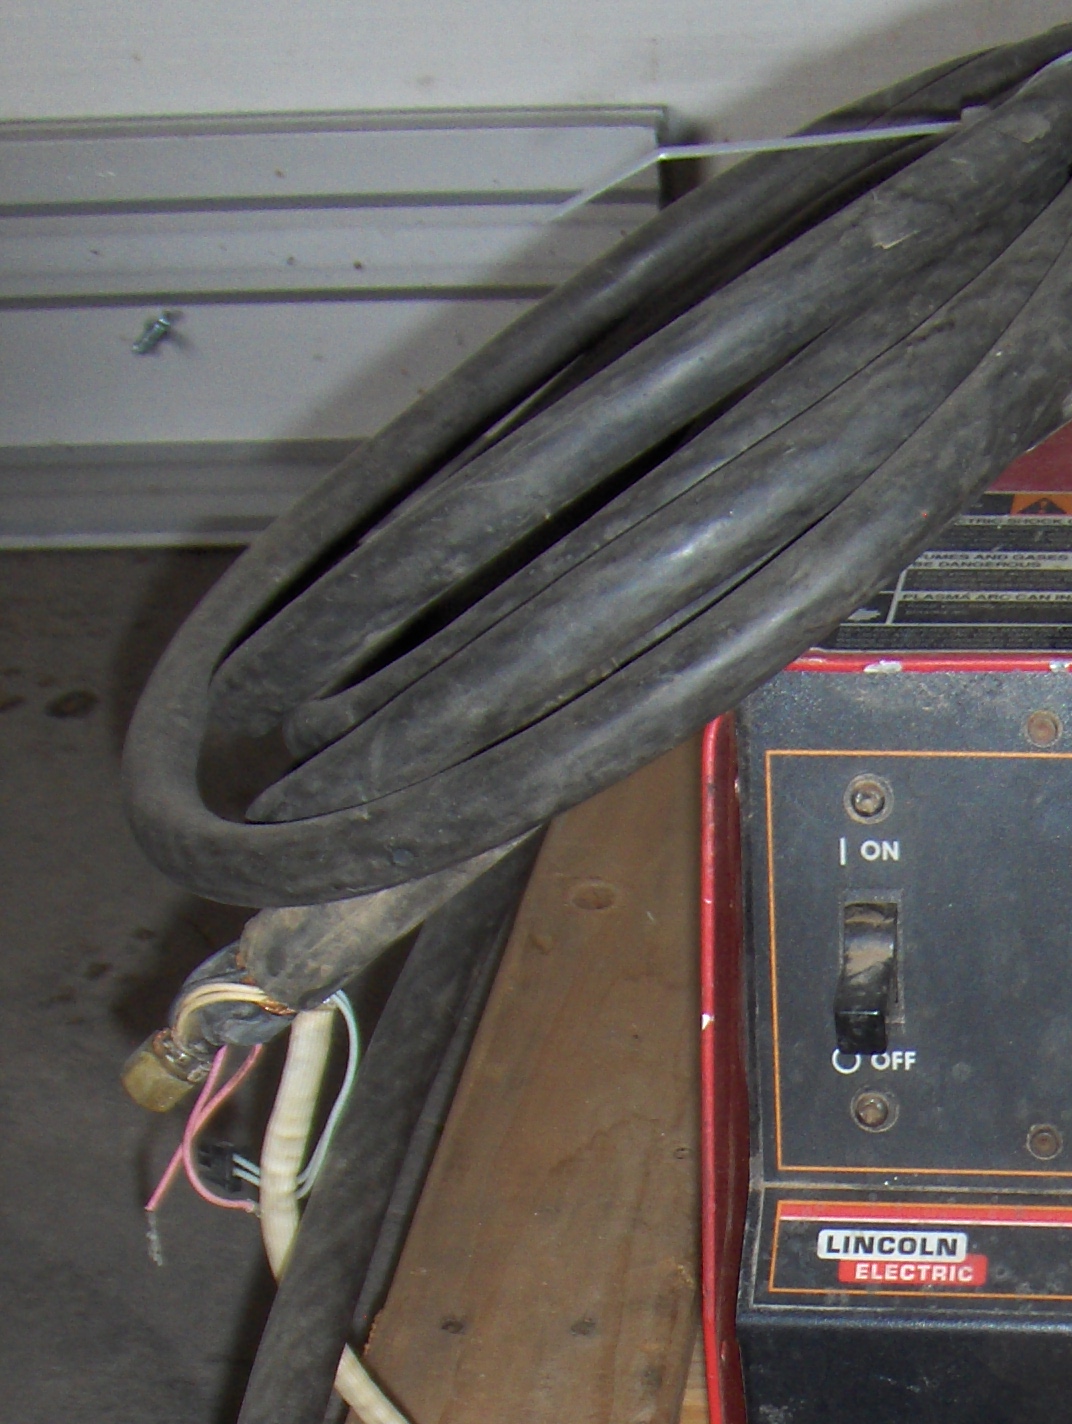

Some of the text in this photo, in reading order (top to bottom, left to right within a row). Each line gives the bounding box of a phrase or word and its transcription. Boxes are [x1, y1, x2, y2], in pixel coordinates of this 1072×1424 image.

[902, 593, 970, 601] PLASMA
[860, 840, 900, 861] ON
[871, 1052, 917, 1071] OFF
[826, 1235, 958, 1257] LINCOLN
[854, 1262, 974, 1283] ELECTRIC
